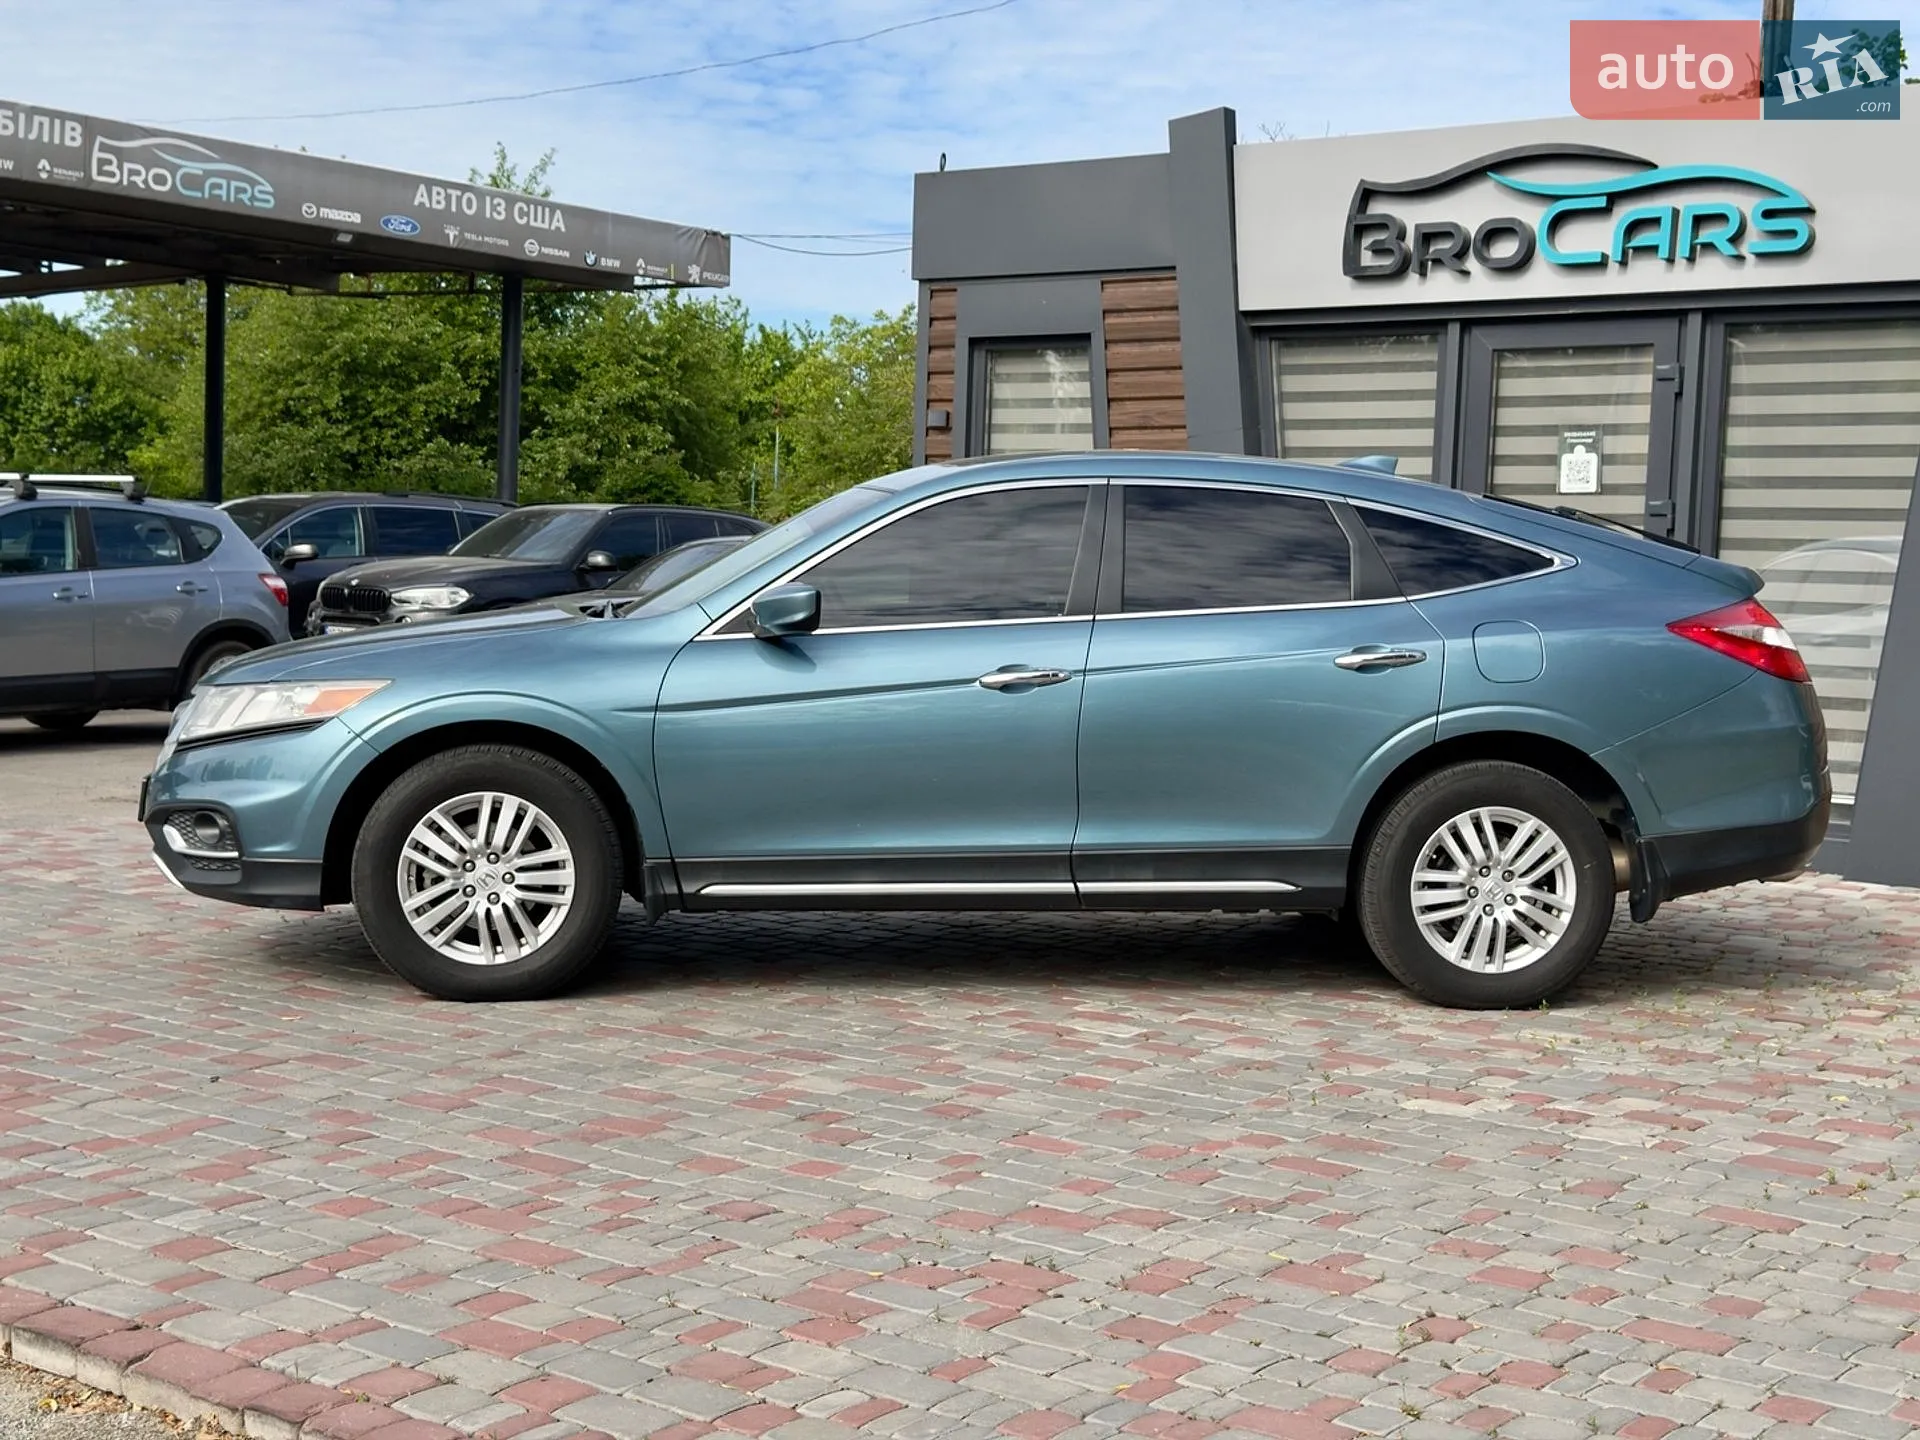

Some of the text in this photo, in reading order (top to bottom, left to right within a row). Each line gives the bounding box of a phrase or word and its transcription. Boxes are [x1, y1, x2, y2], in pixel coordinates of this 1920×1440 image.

[413, 183, 478, 216] АВТО
[513, 202, 566, 232] США
[540, 246, 571, 259] NISSAN
